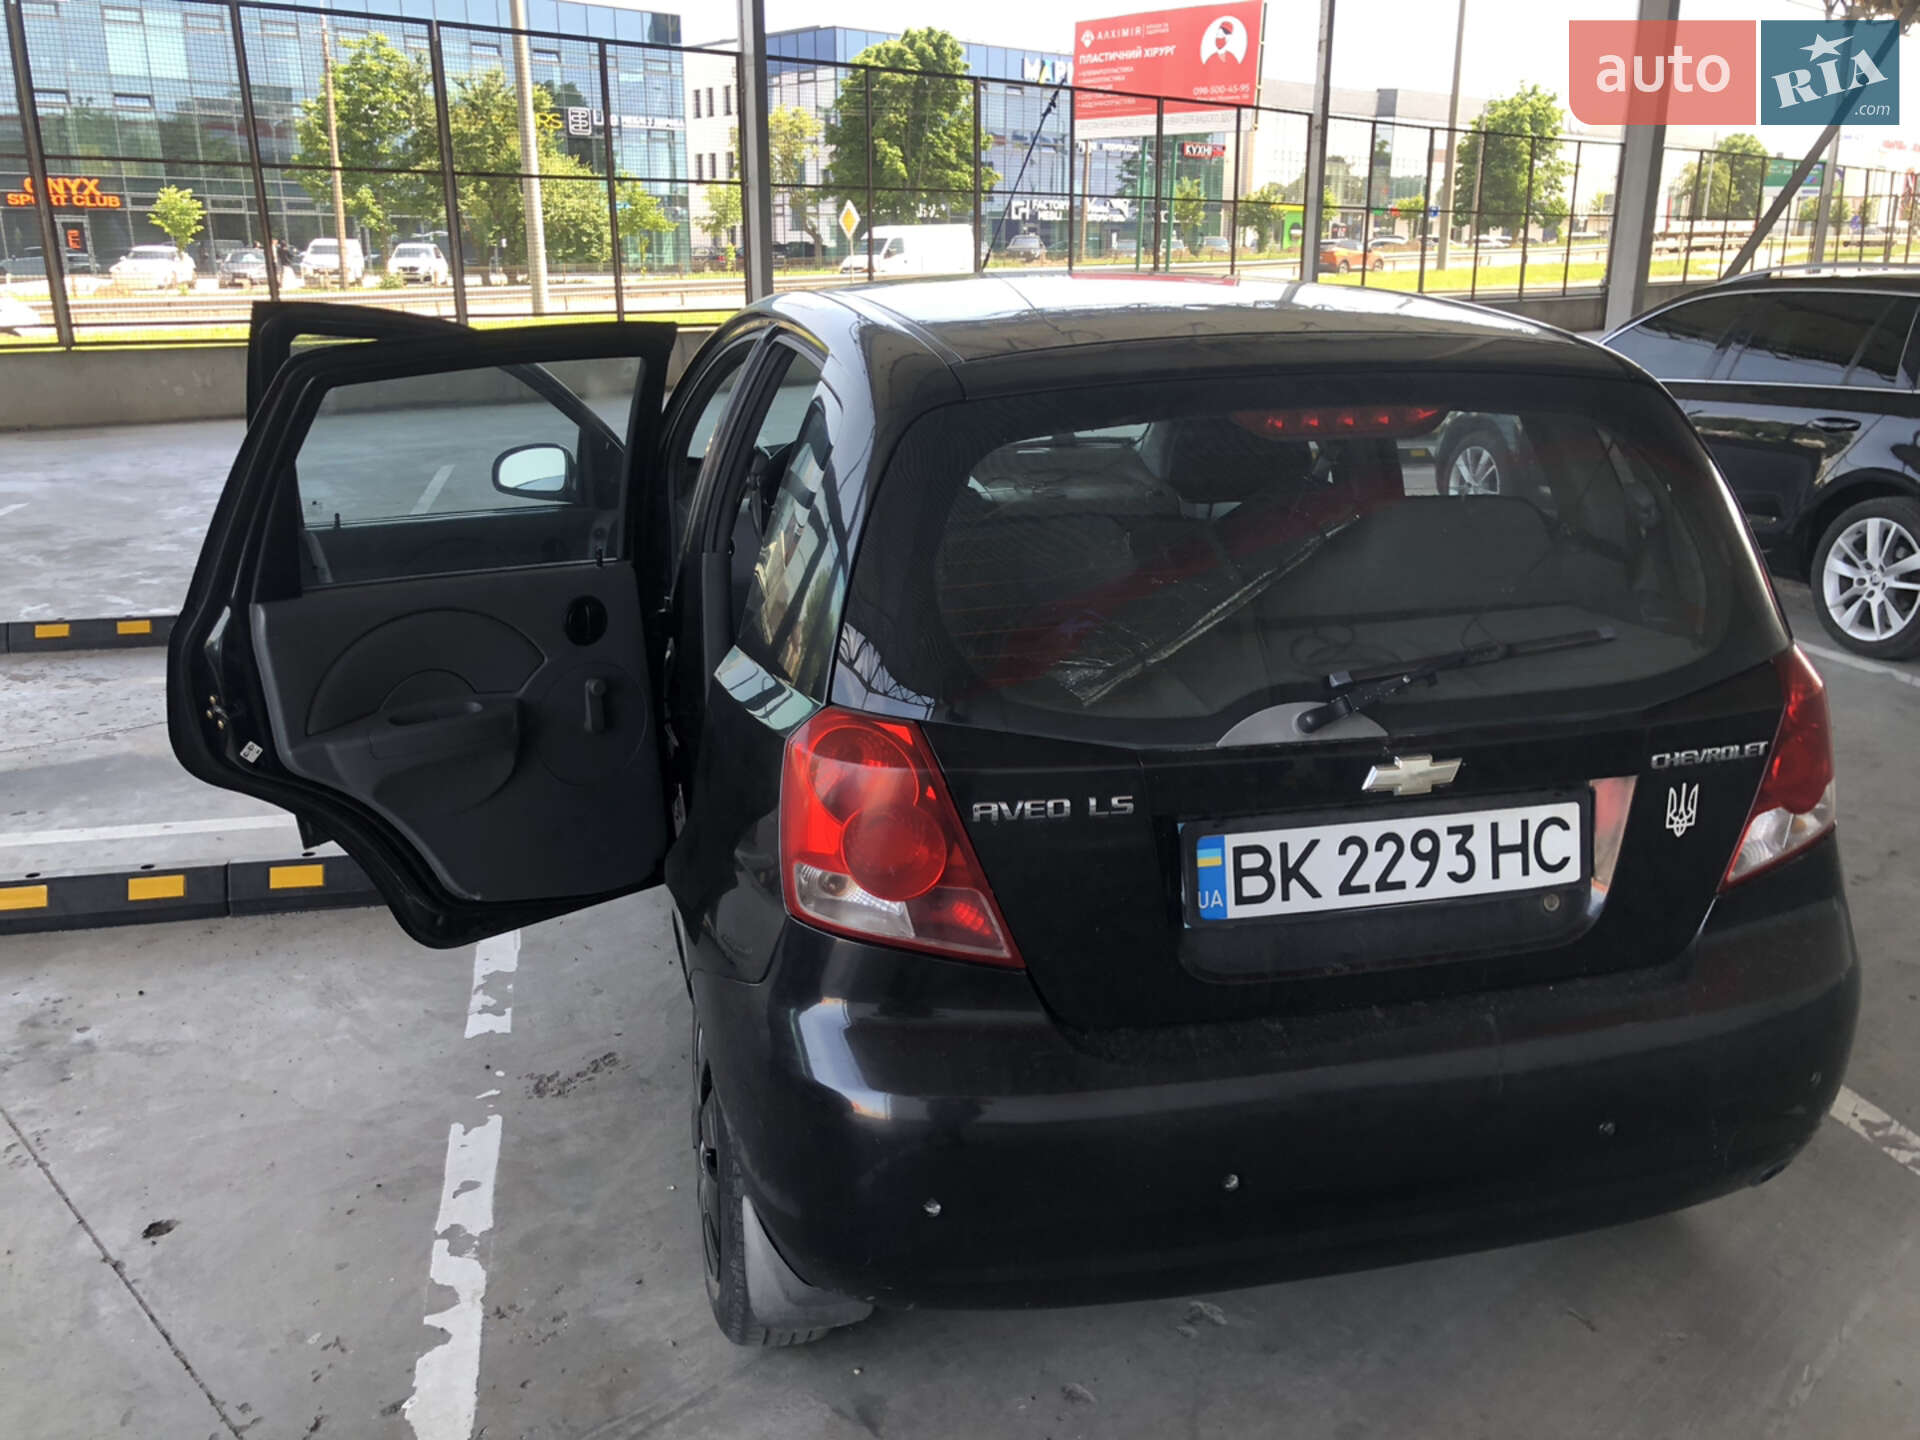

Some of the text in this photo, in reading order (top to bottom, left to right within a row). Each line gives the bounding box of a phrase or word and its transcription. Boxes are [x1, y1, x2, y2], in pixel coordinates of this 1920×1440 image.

[1079, 45, 1176, 65] ПЛАСТИЧНИЙ ХІРУРГ
[6, 193, 121, 208] SPRT CLUB
[1032, 199, 1070, 211] FACTOR
[1651, 741, 1768, 769] CHEVROLET
[972, 795, 1134, 822] AVEO LS
[1233, 816, 1572, 906] BK 2293 HC
[1197, 889, 1224, 909] UA
